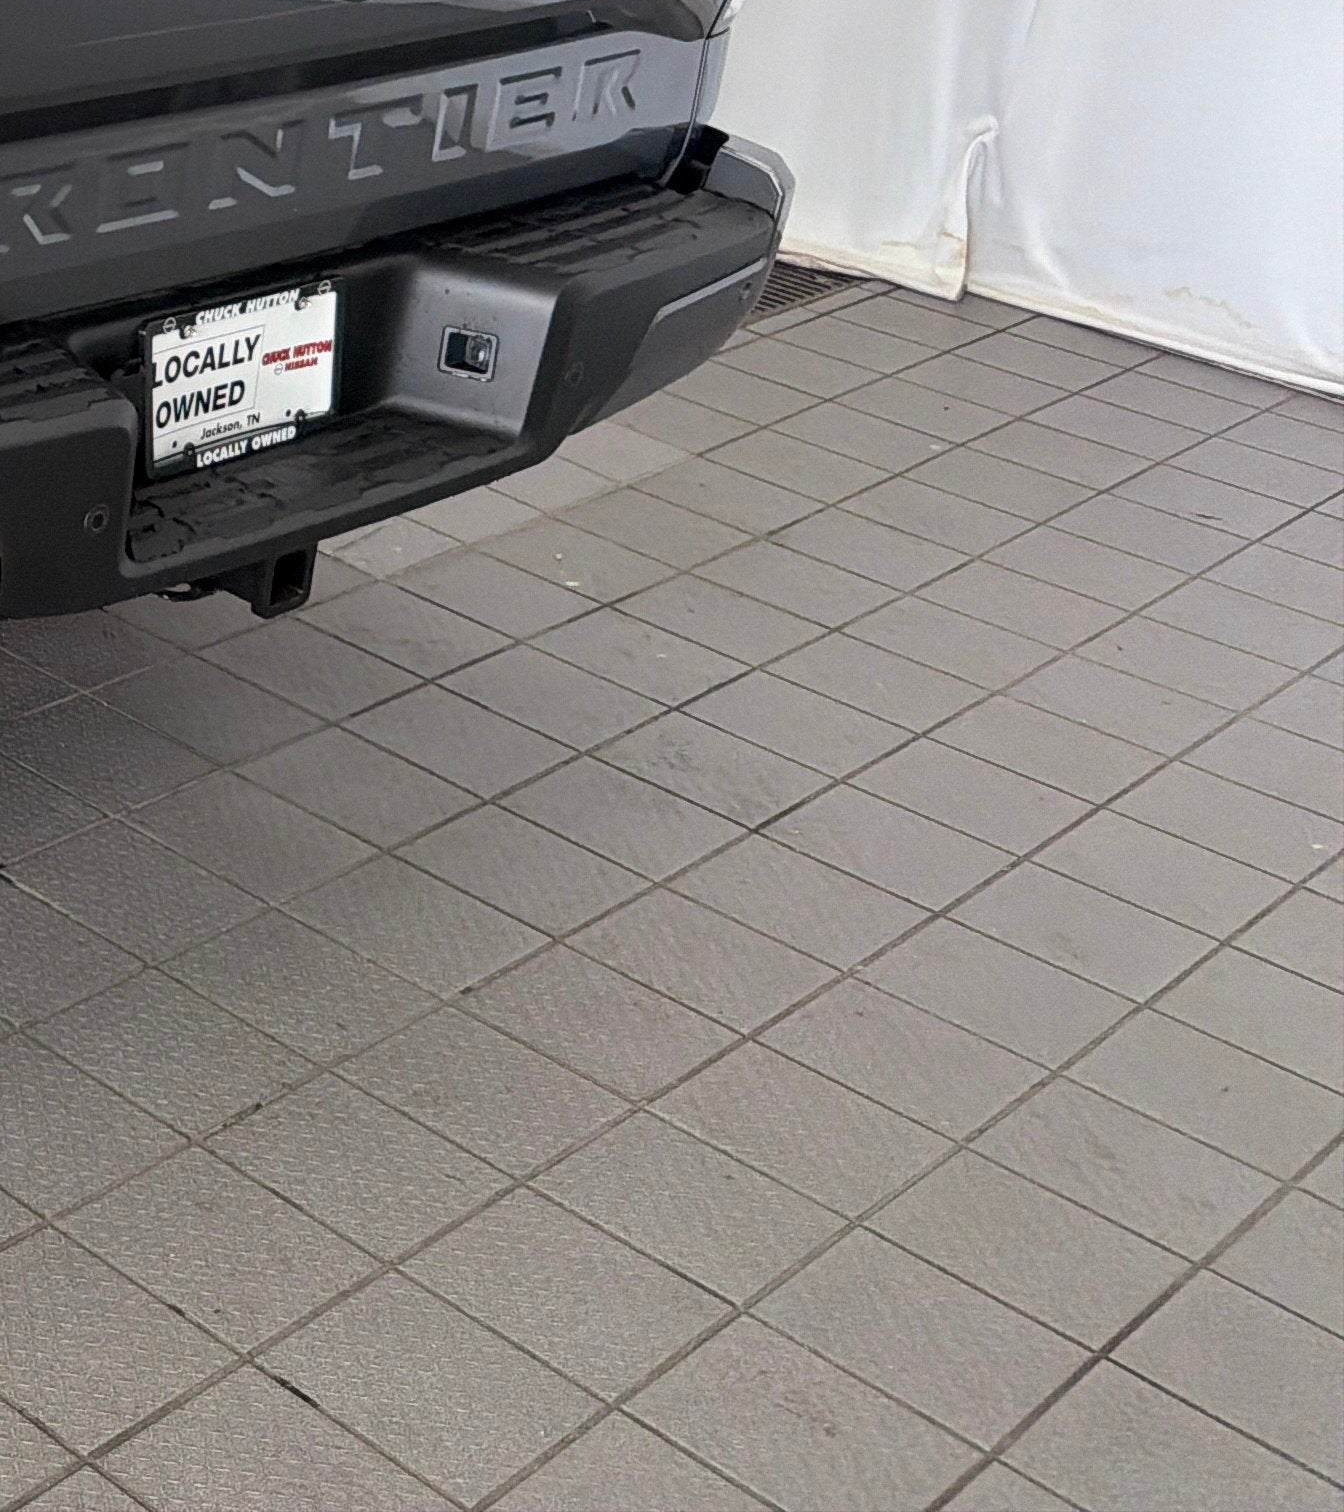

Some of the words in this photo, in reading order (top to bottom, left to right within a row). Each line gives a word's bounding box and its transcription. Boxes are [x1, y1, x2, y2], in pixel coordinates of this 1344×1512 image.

[195, 303, 242, 326] CHUCK
[245, 288, 300, 313] HUTTON
[152, 333, 261, 389] LOCALLY
[261, 348, 291, 366] CHUCK
[292, 339, 333, 360] HUTTON
[284, 356, 319, 372] NISSAN
[155, 379, 246, 429] OWNED
[200, 420, 243, 441] Jackson,
[246, 412, 261, 427] TN
[196, 440, 248, 468] LOCALLY
[251, 425, 297, 451] OWNED
